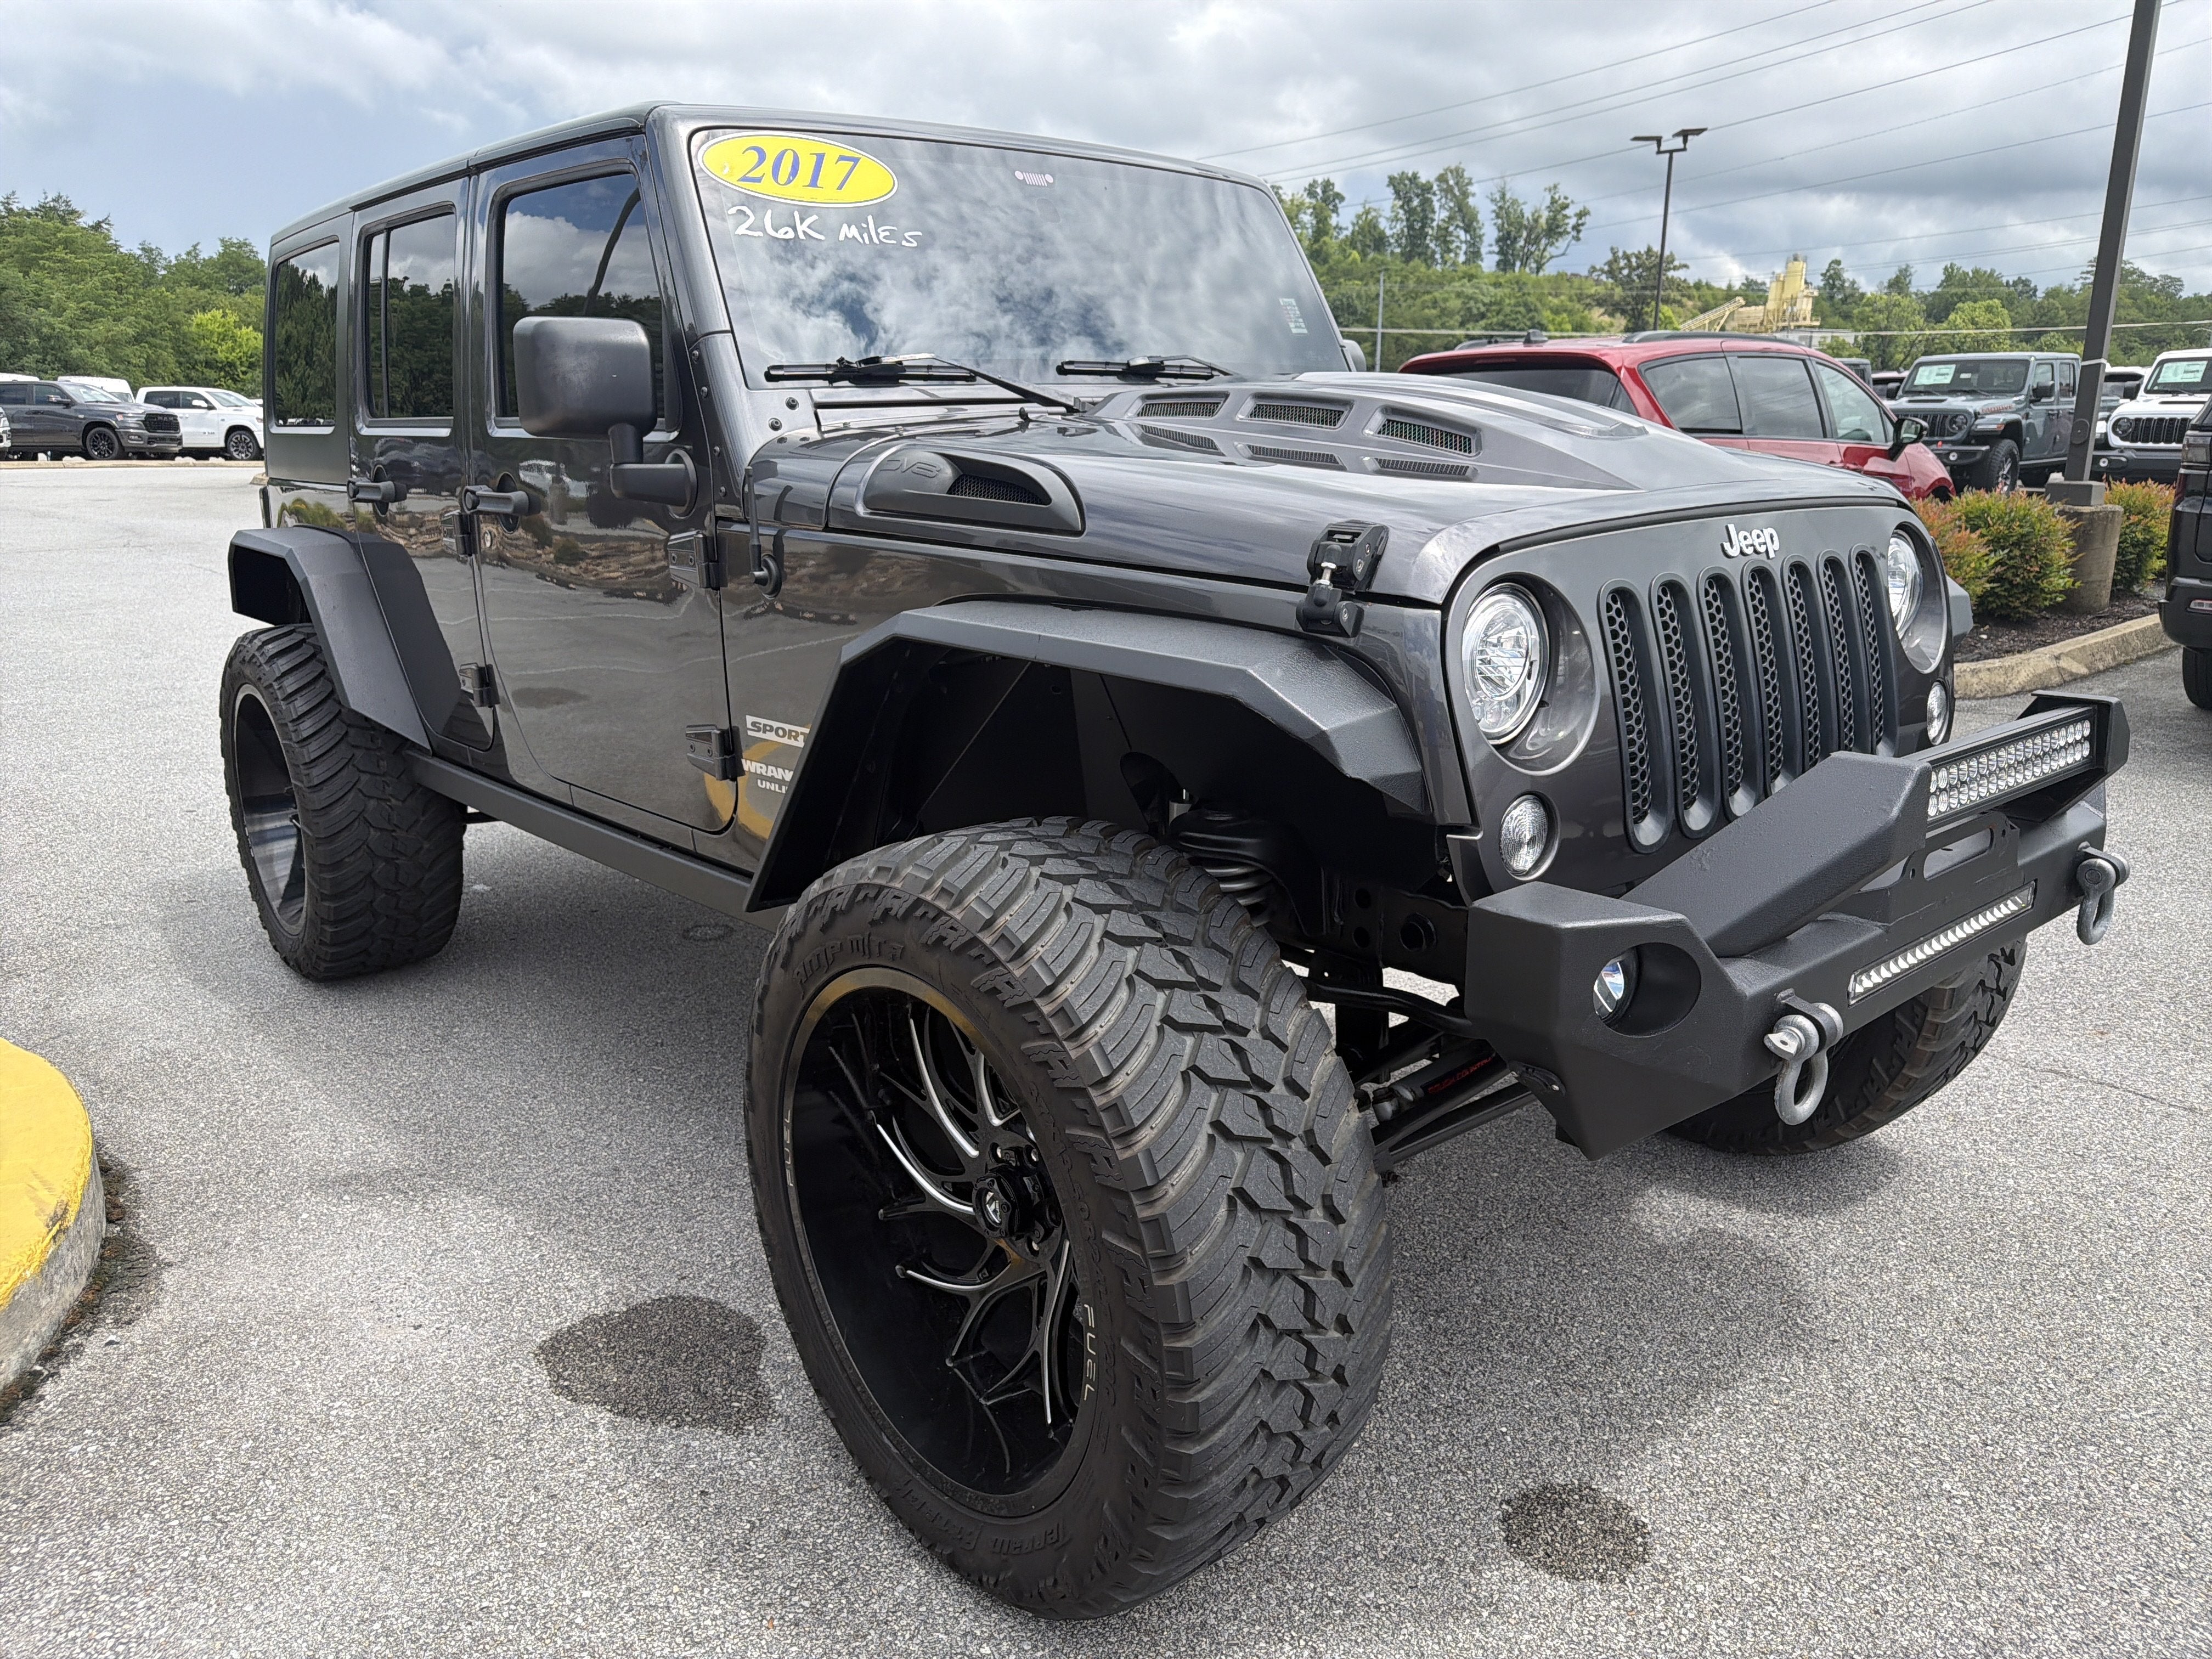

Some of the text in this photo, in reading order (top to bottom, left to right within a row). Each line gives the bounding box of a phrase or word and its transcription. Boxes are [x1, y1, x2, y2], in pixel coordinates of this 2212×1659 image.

[737, 145, 862, 191] 2017
[727, 206, 825, 240] 26K
[879, 457, 942, 478] DV8
[1720, 523, 1780, 560] Jeep
[751, 721, 809, 743] SPORT
[784, 1109, 794, 1187] FUEL
[1084, 1304, 1096, 1401] FUEL
